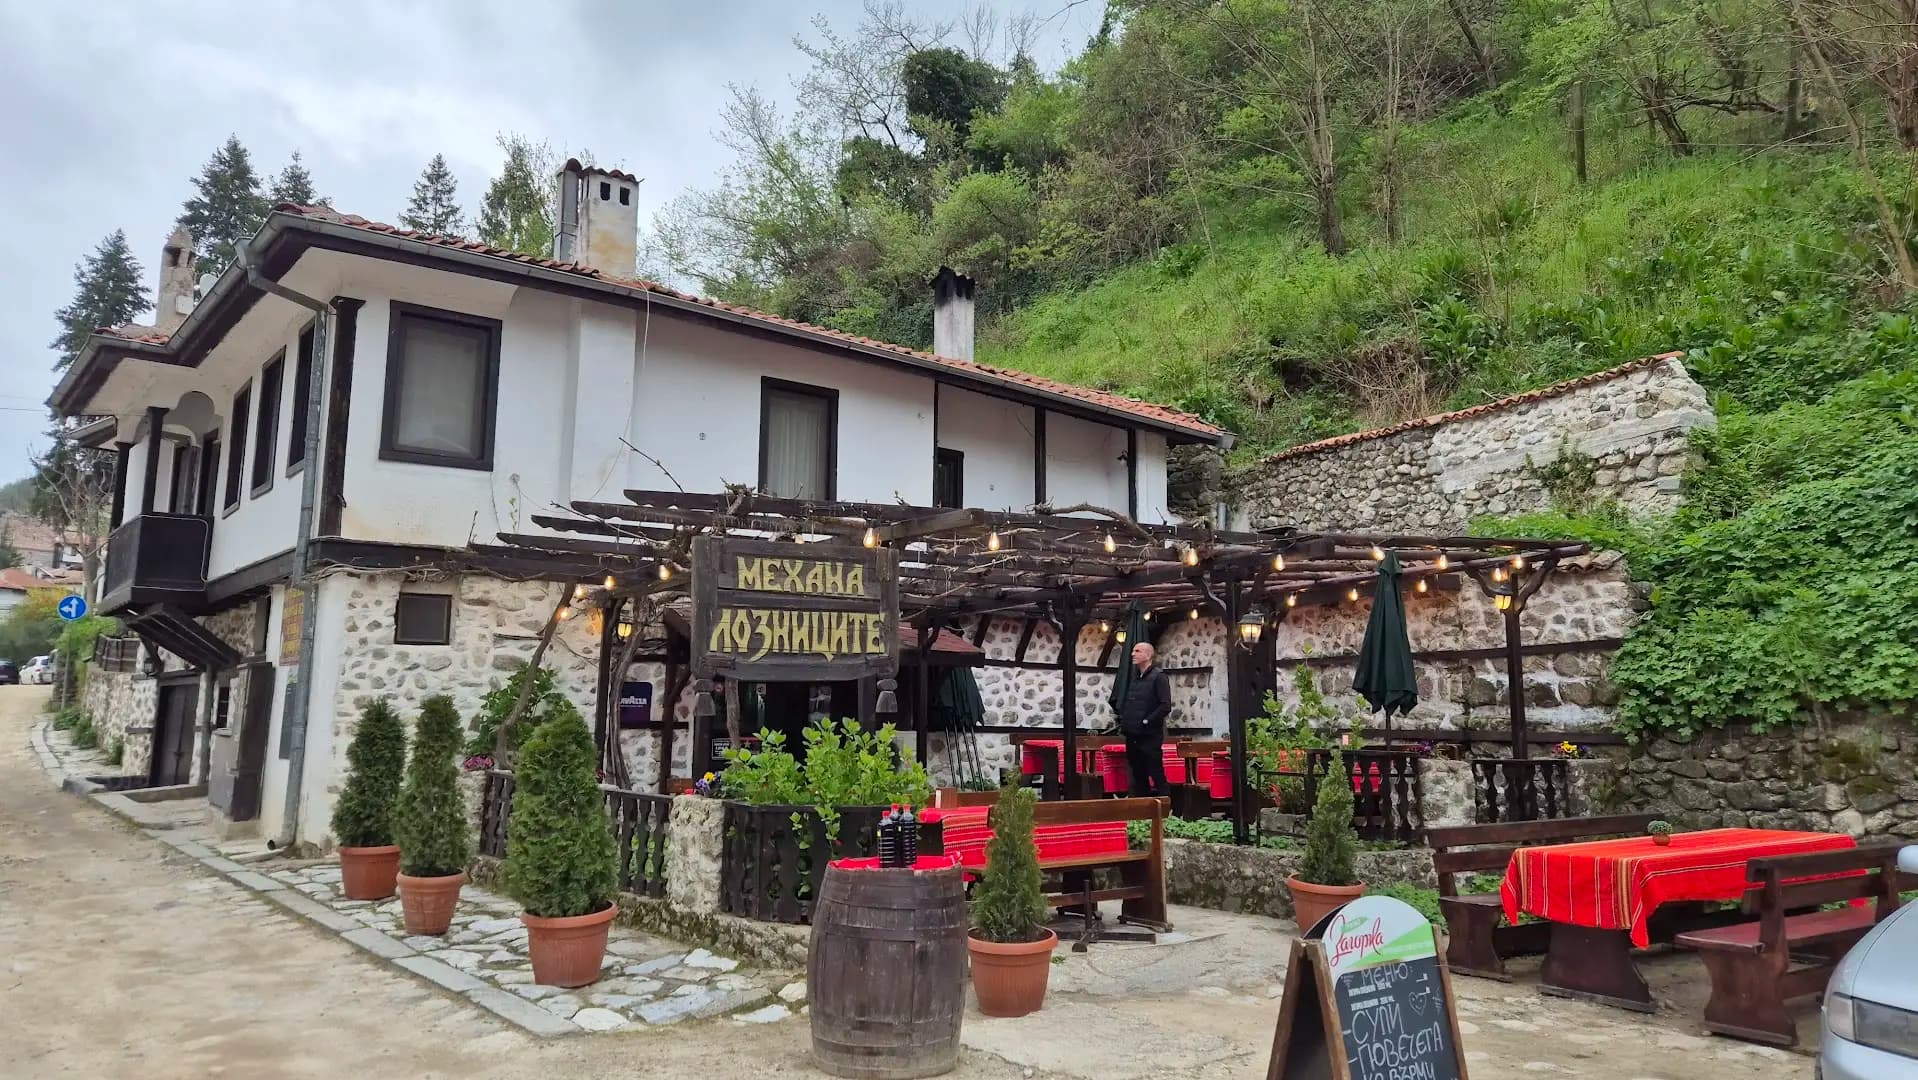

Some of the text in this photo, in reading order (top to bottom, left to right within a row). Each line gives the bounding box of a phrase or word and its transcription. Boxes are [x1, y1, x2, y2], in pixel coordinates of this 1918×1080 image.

[736, 556, 865, 596] МЕХАНА
[709, 608, 887, 663] ЛОЗНИЦИТЕ
[1351, 1003, 1405, 1045] СУПИ
